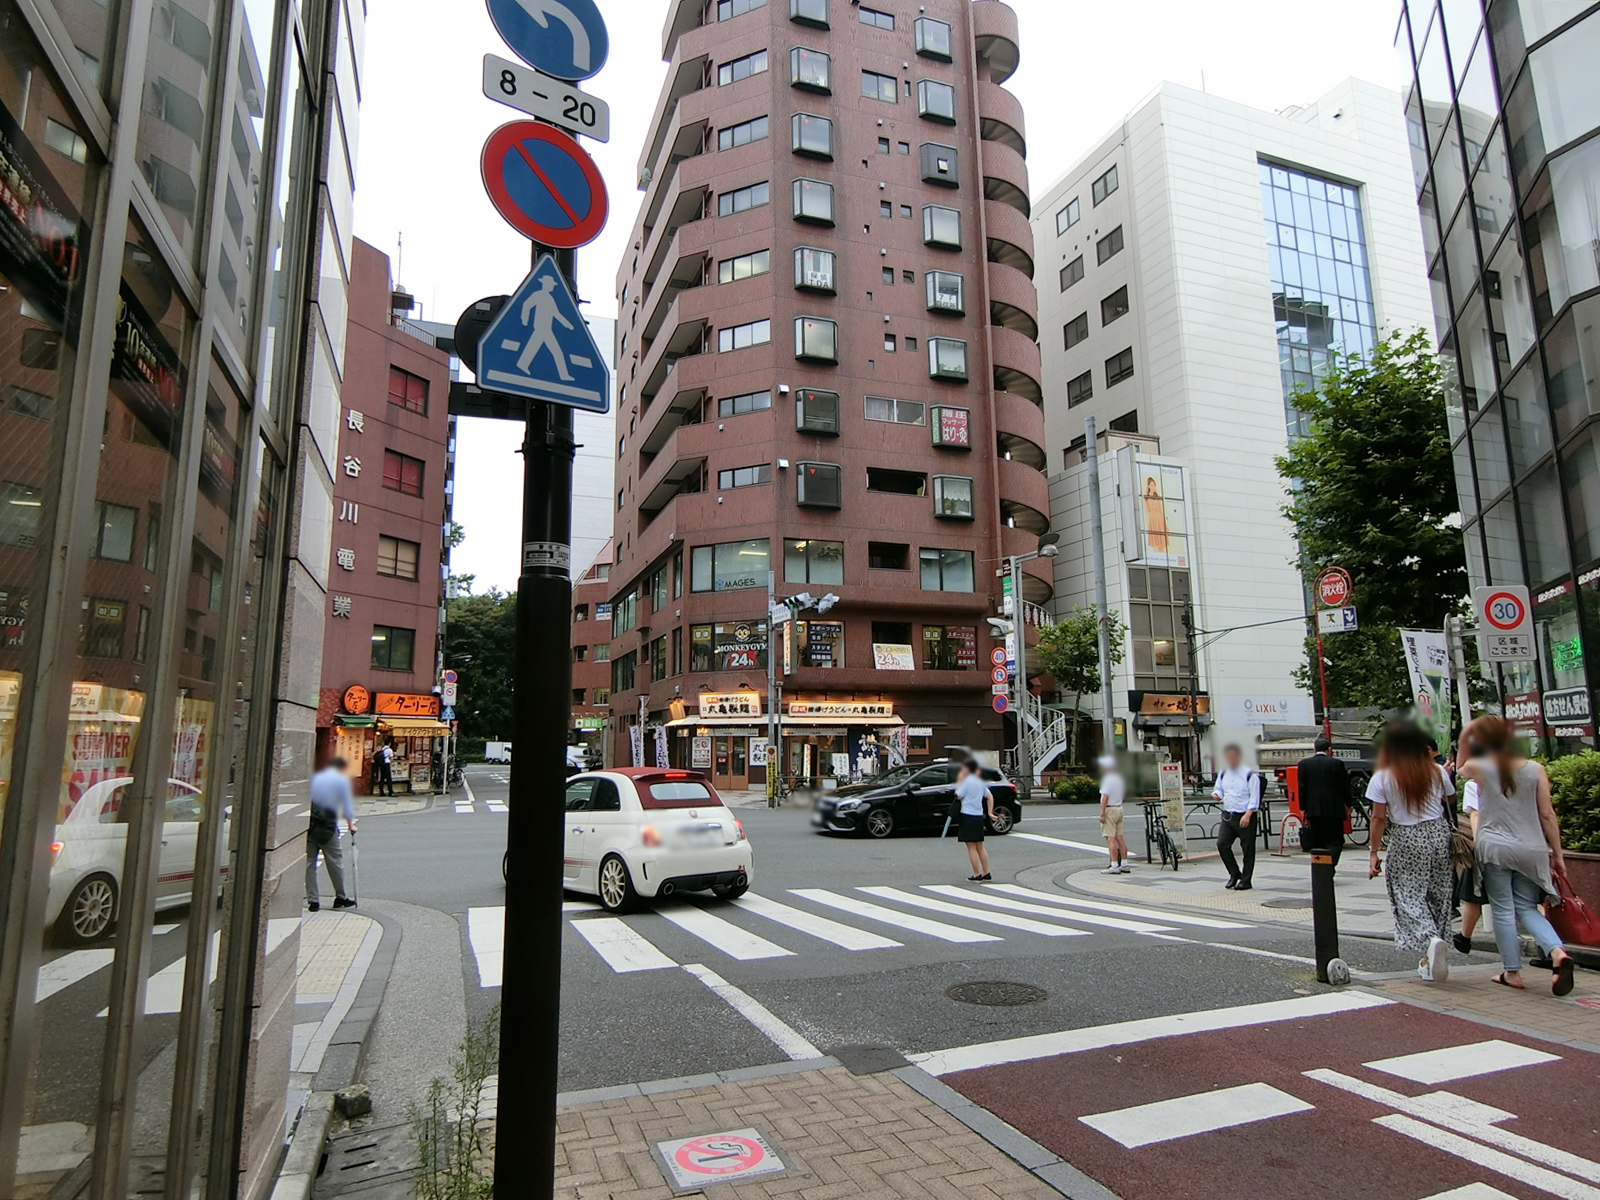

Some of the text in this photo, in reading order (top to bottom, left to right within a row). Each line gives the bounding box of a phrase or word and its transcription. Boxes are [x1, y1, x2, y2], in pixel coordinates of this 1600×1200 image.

[500, 69, 517, 96] 8
[562, 95, 596, 127] 20
[941, 409, 967, 419] 指圧
[941, 418, 967, 427] マッサージ
[332, 409, 364, 618] 長谷川電業
[1321, 582, 1345, 597] 消火栓
[1494, 602, 1516, 620] 30
[717, 642, 768, 653] MONKEYGYM
[1498, 637, 1519, 646] 区域
[994, 652, 1004, 662] 40
[1491, 646, 1528, 656] ここまで
[730, 653, 754, 667] 24h
[877, 652, 900, 667] 24h
[395, 695, 437, 715] ターリー屋
[707, 704, 750, 714] 丸亀製麺
[851, 706, 885, 714] 丸亀製麺
[1255, 704, 1277, 714] LIXIL
[1546, 696, 1590, 718] 処方せん受付
[71, 732, 131, 761] SUMMER
[65, 766, 128, 821] SALE
